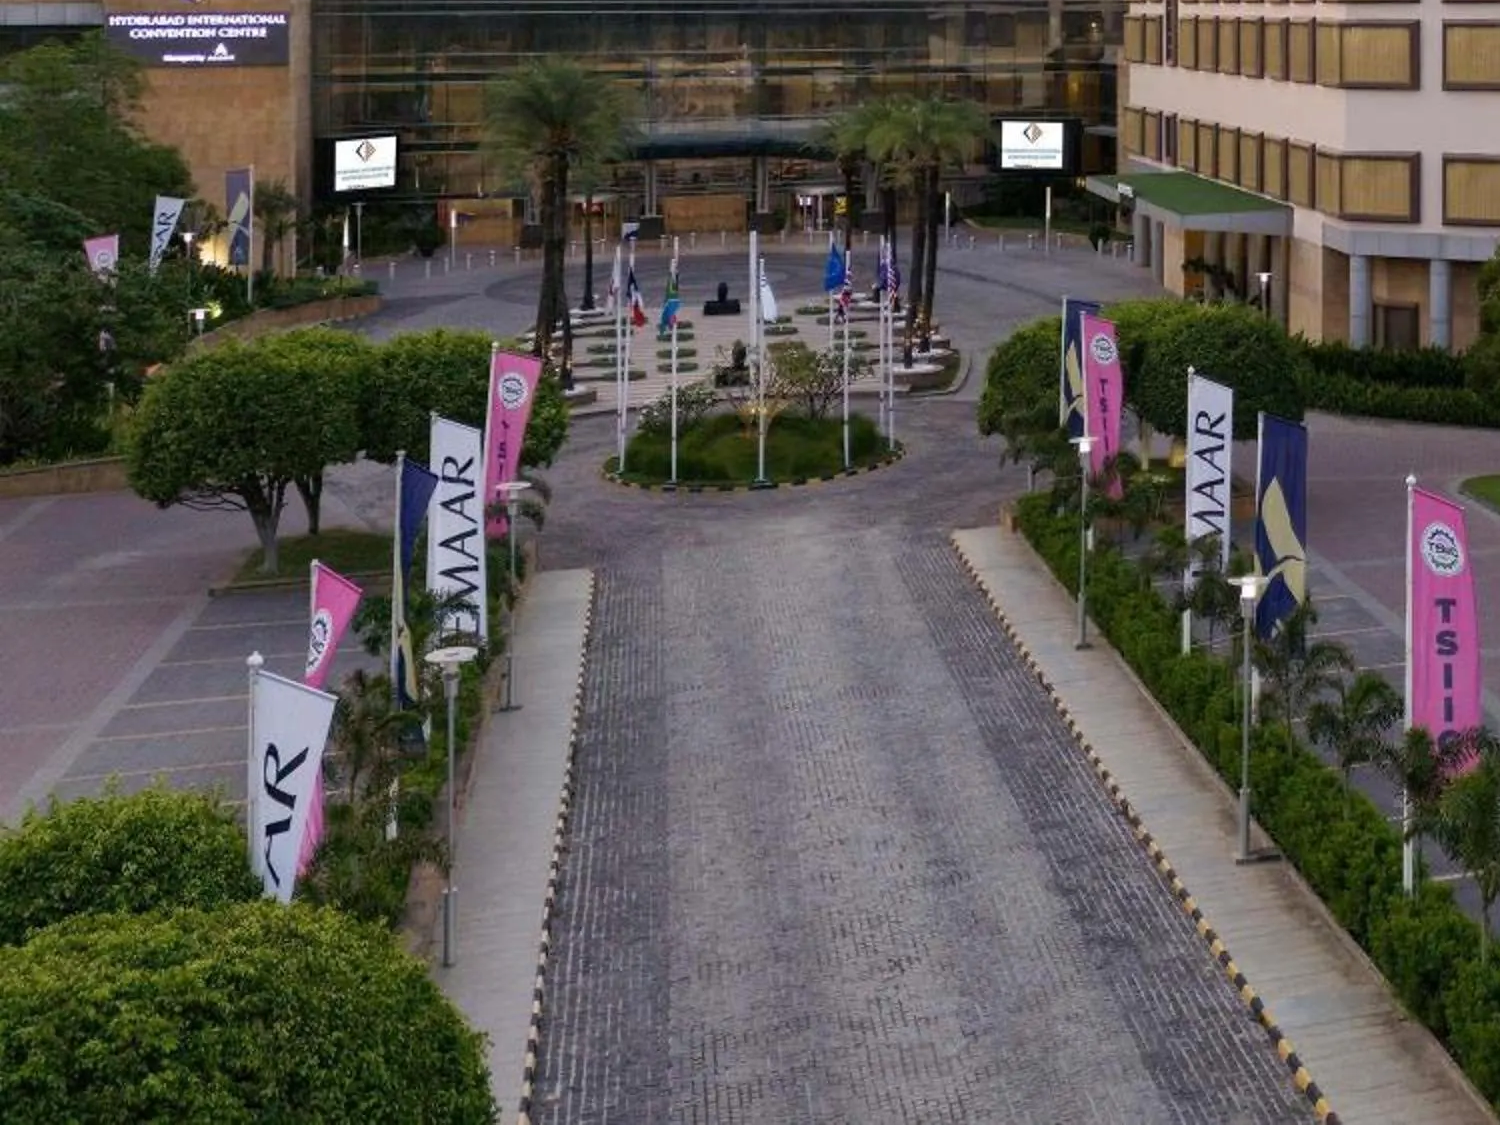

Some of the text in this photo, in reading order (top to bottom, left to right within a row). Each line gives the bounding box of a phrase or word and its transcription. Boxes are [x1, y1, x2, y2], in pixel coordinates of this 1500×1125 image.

[109, 13, 286, 26] HYDERABAD INTERNATIONAL
[129, 26, 268, 39] CONVENTION CENTRE
